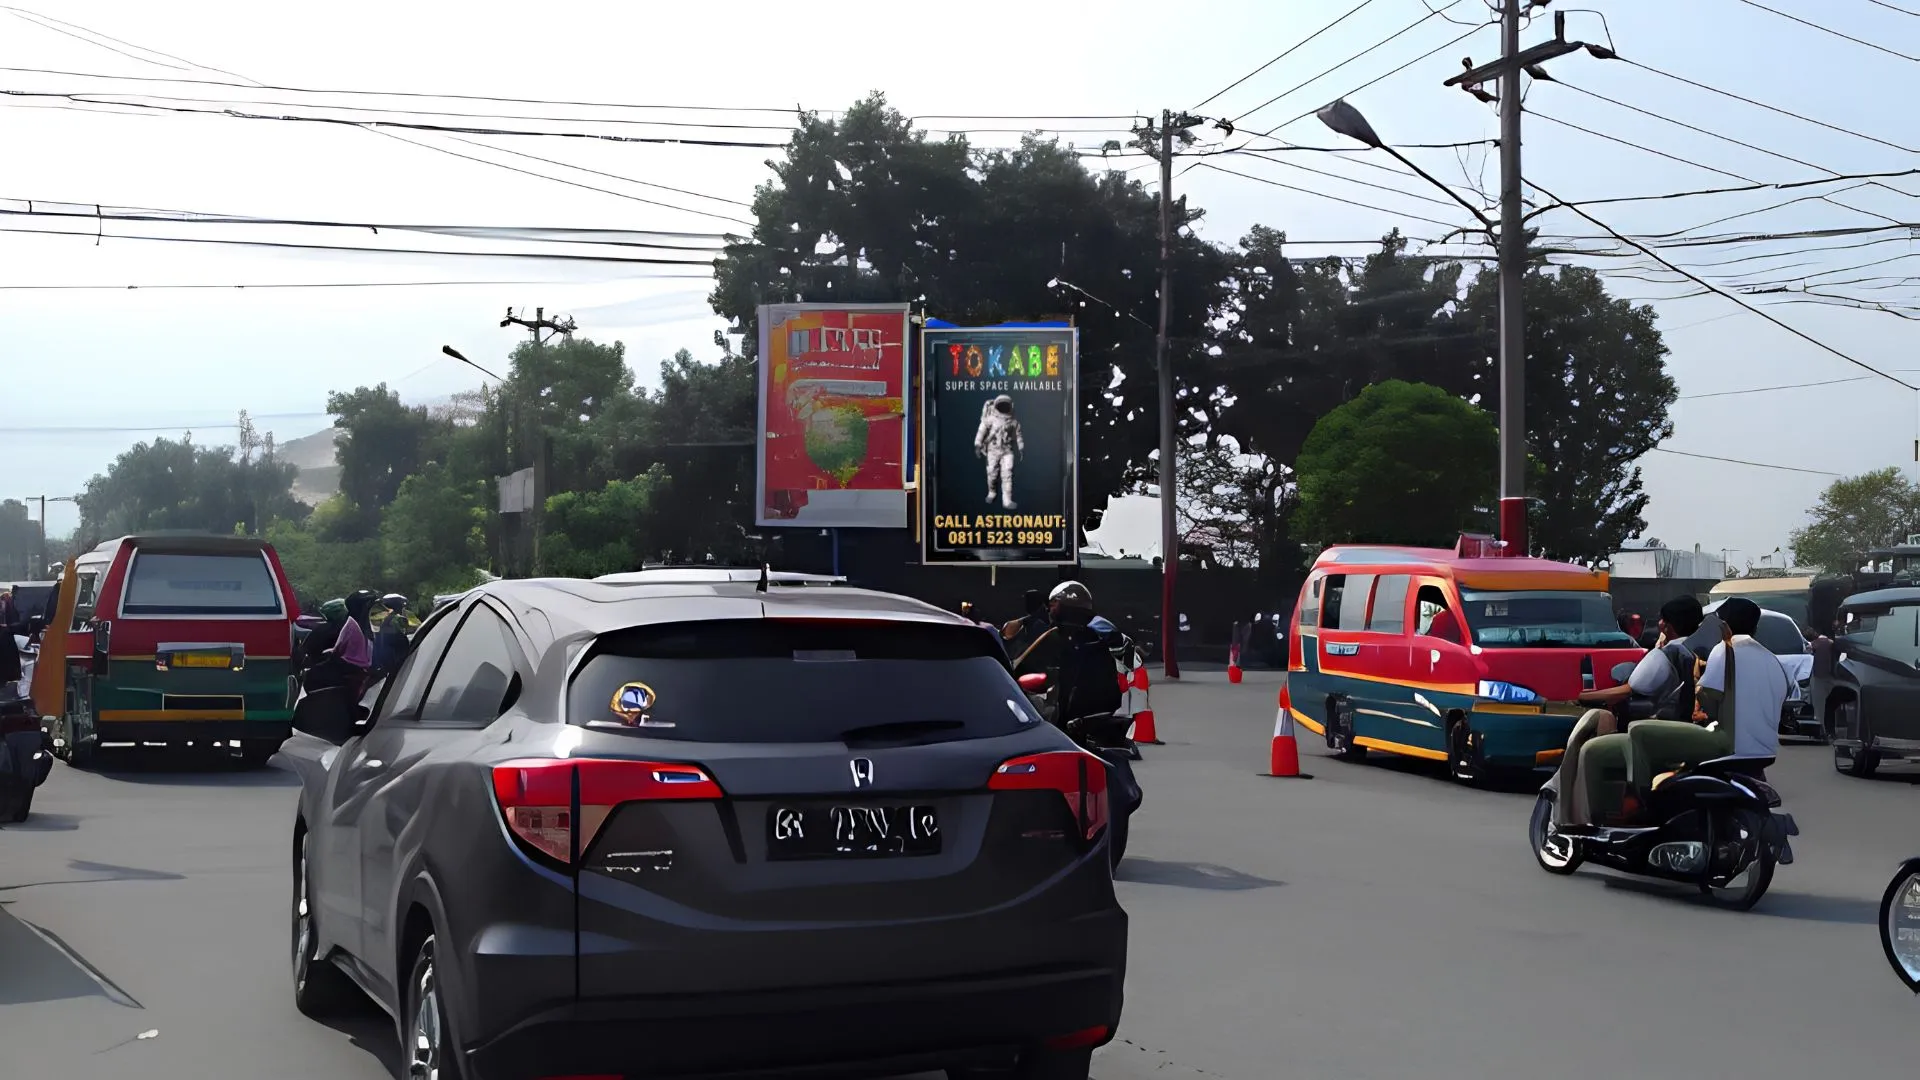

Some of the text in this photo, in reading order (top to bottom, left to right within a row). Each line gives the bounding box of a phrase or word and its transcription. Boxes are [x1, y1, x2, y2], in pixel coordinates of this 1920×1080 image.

[949, 344, 1059, 377] TOKABE
[945, 380, 1062, 391] SUPER SPACE AVAILABLE
[935, 515, 1066, 528] CALL ASTRONAUT:
[948, 531, 1053, 544] 0811 523 9999
